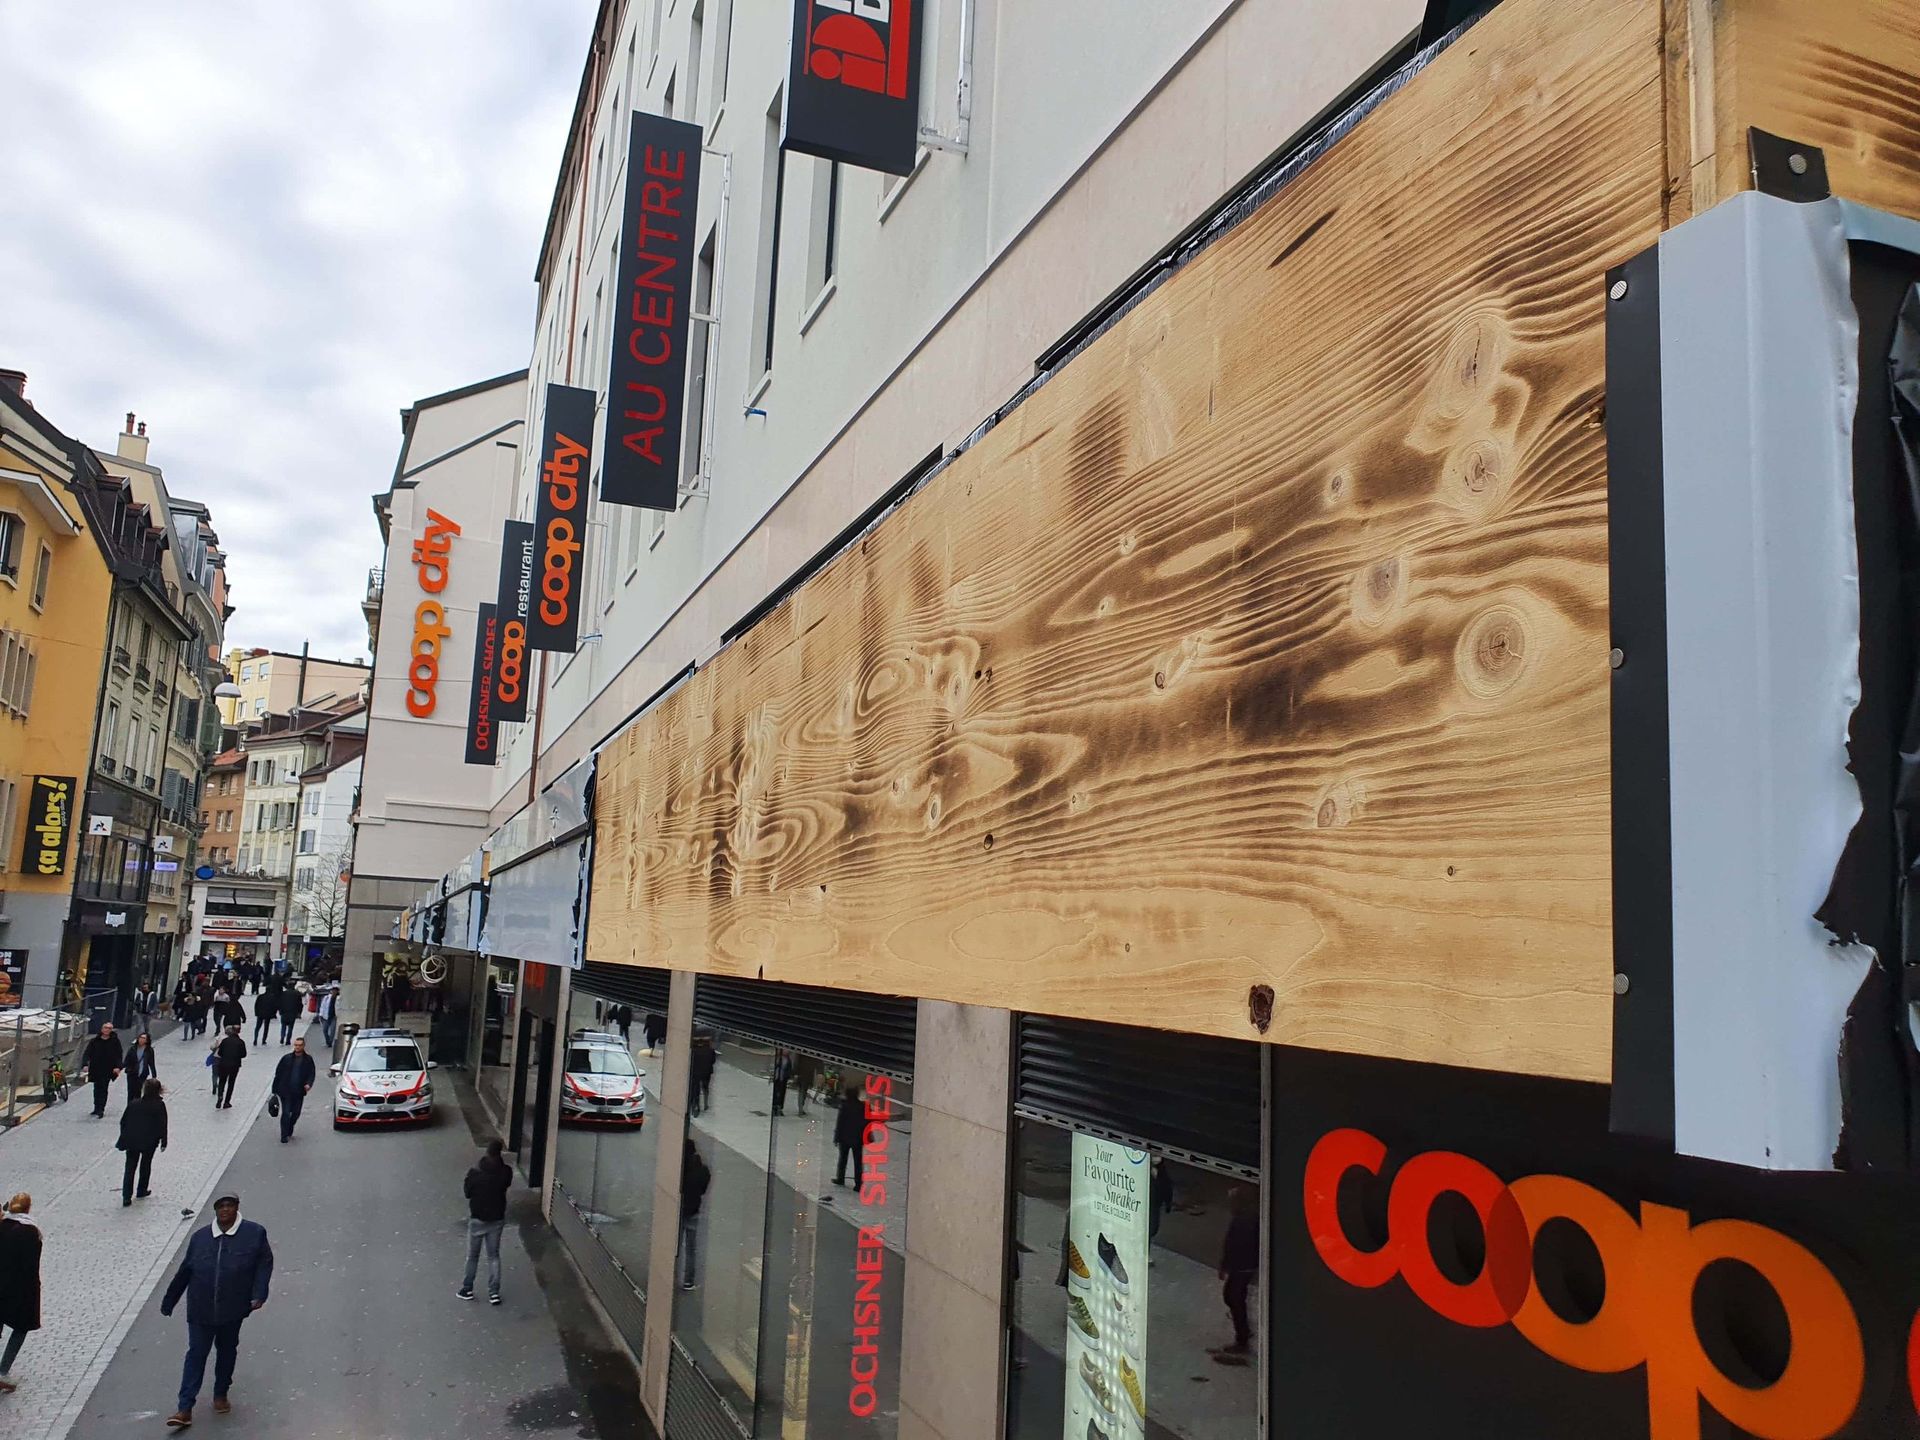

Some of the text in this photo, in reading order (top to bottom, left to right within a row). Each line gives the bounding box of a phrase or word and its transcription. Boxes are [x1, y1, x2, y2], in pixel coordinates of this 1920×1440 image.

[622, 144, 685, 465] AU CENTRE
[540, 431, 589, 626] coop city
[406, 508, 461, 718] coop city
[498, 540, 533, 703] coop restaurant
[38, 850, 62, 874] ça
[358, 1074, 413, 1083] POLICE
[1095, 1143, 1113, 1164] Your
[849, 1074, 891, 1418] OCHSNER SHOES
[1084, 1156, 1135, 1193] Favourite
[1104, 1184, 1141, 1213] Sneaker
[1303, 1127, 1866, 1440] coop
